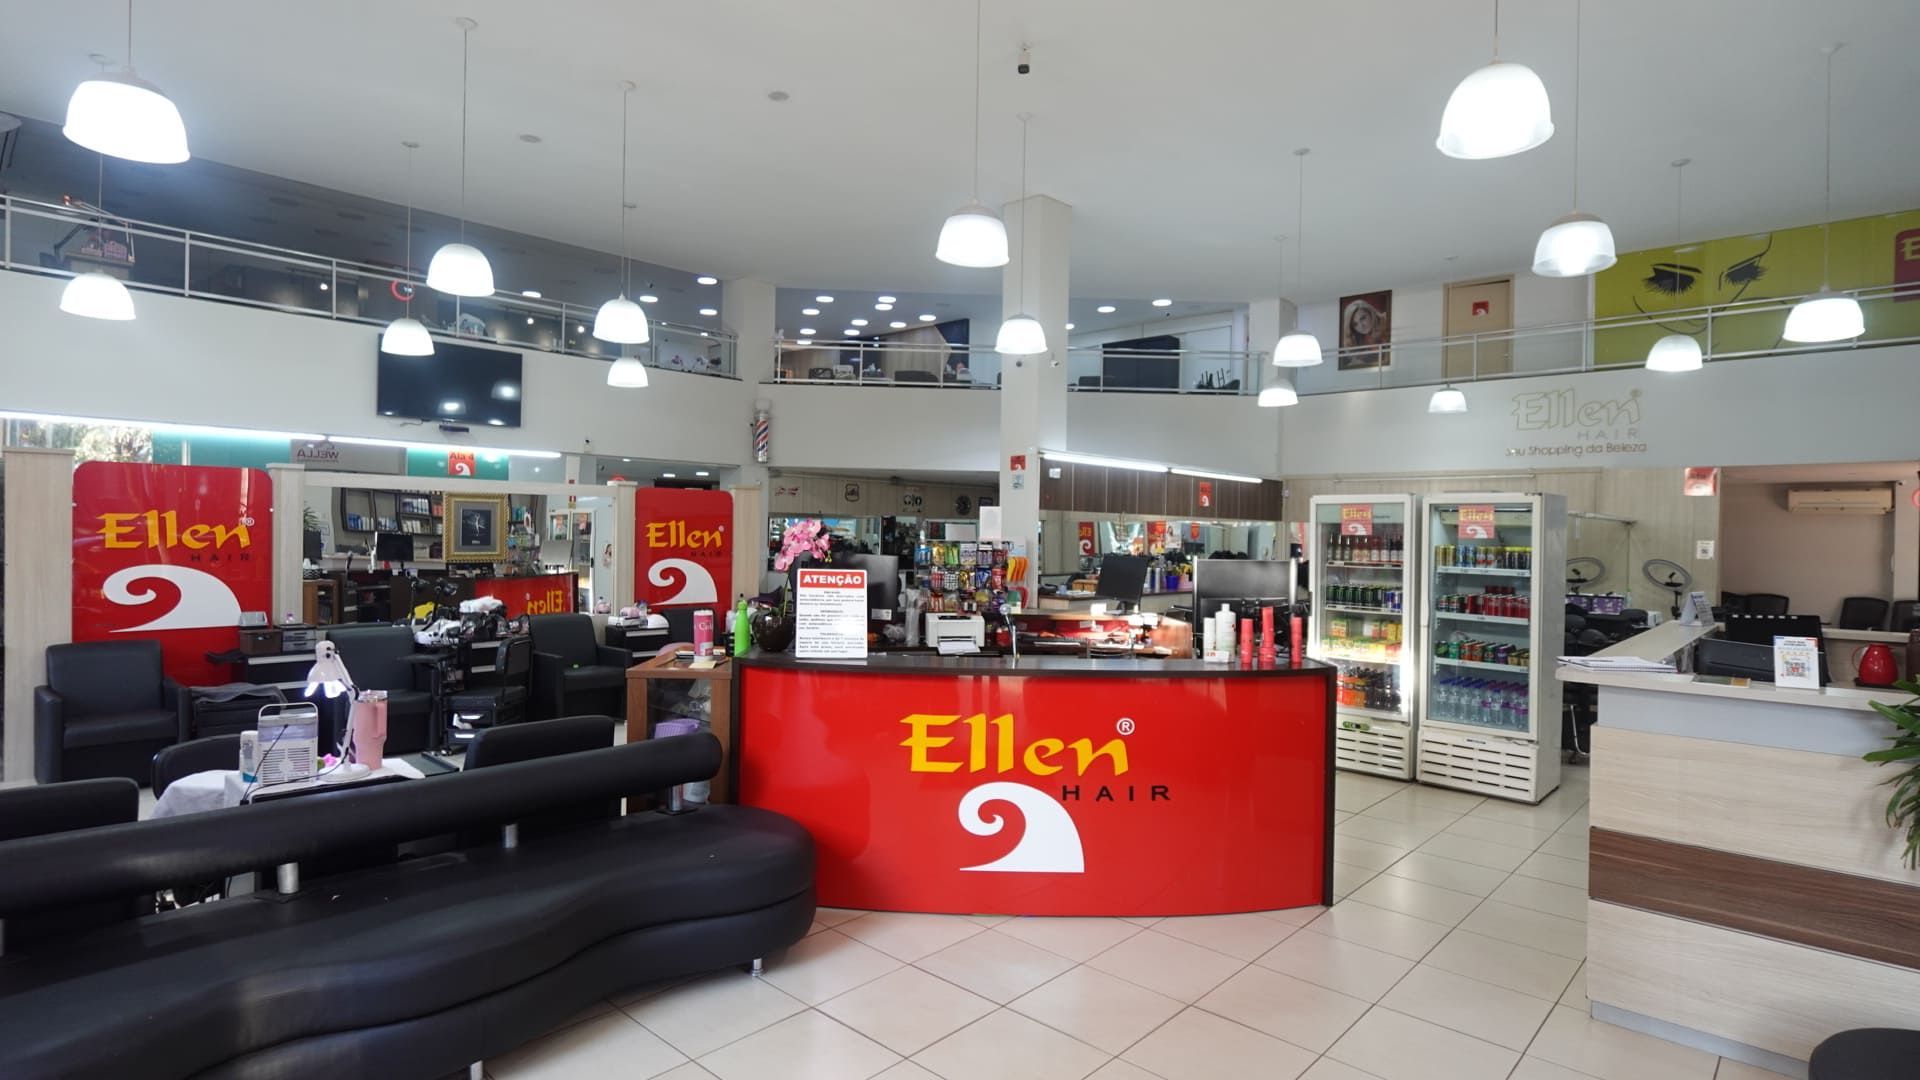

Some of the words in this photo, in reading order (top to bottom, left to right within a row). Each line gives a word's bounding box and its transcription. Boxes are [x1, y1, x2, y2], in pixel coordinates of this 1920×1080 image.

[1511, 387, 1640, 431] Ellen
[1577, 427, 1638, 440] HAIR
[1528, 444, 1583, 459] Shopping
[1585, 444, 1603, 454] da
[1606, 442, 1647, 453] Beleza
[96, 510, 250, 549] Ellen
[645, 520, 722, 548] Ellen
[191, 553, 249, 561] HAIR
[803, 573, 862, 586] ATENÇÃO
[899, 713, 1129, 776] Ellen
[1062, 785, 1171, 801] HAIR
